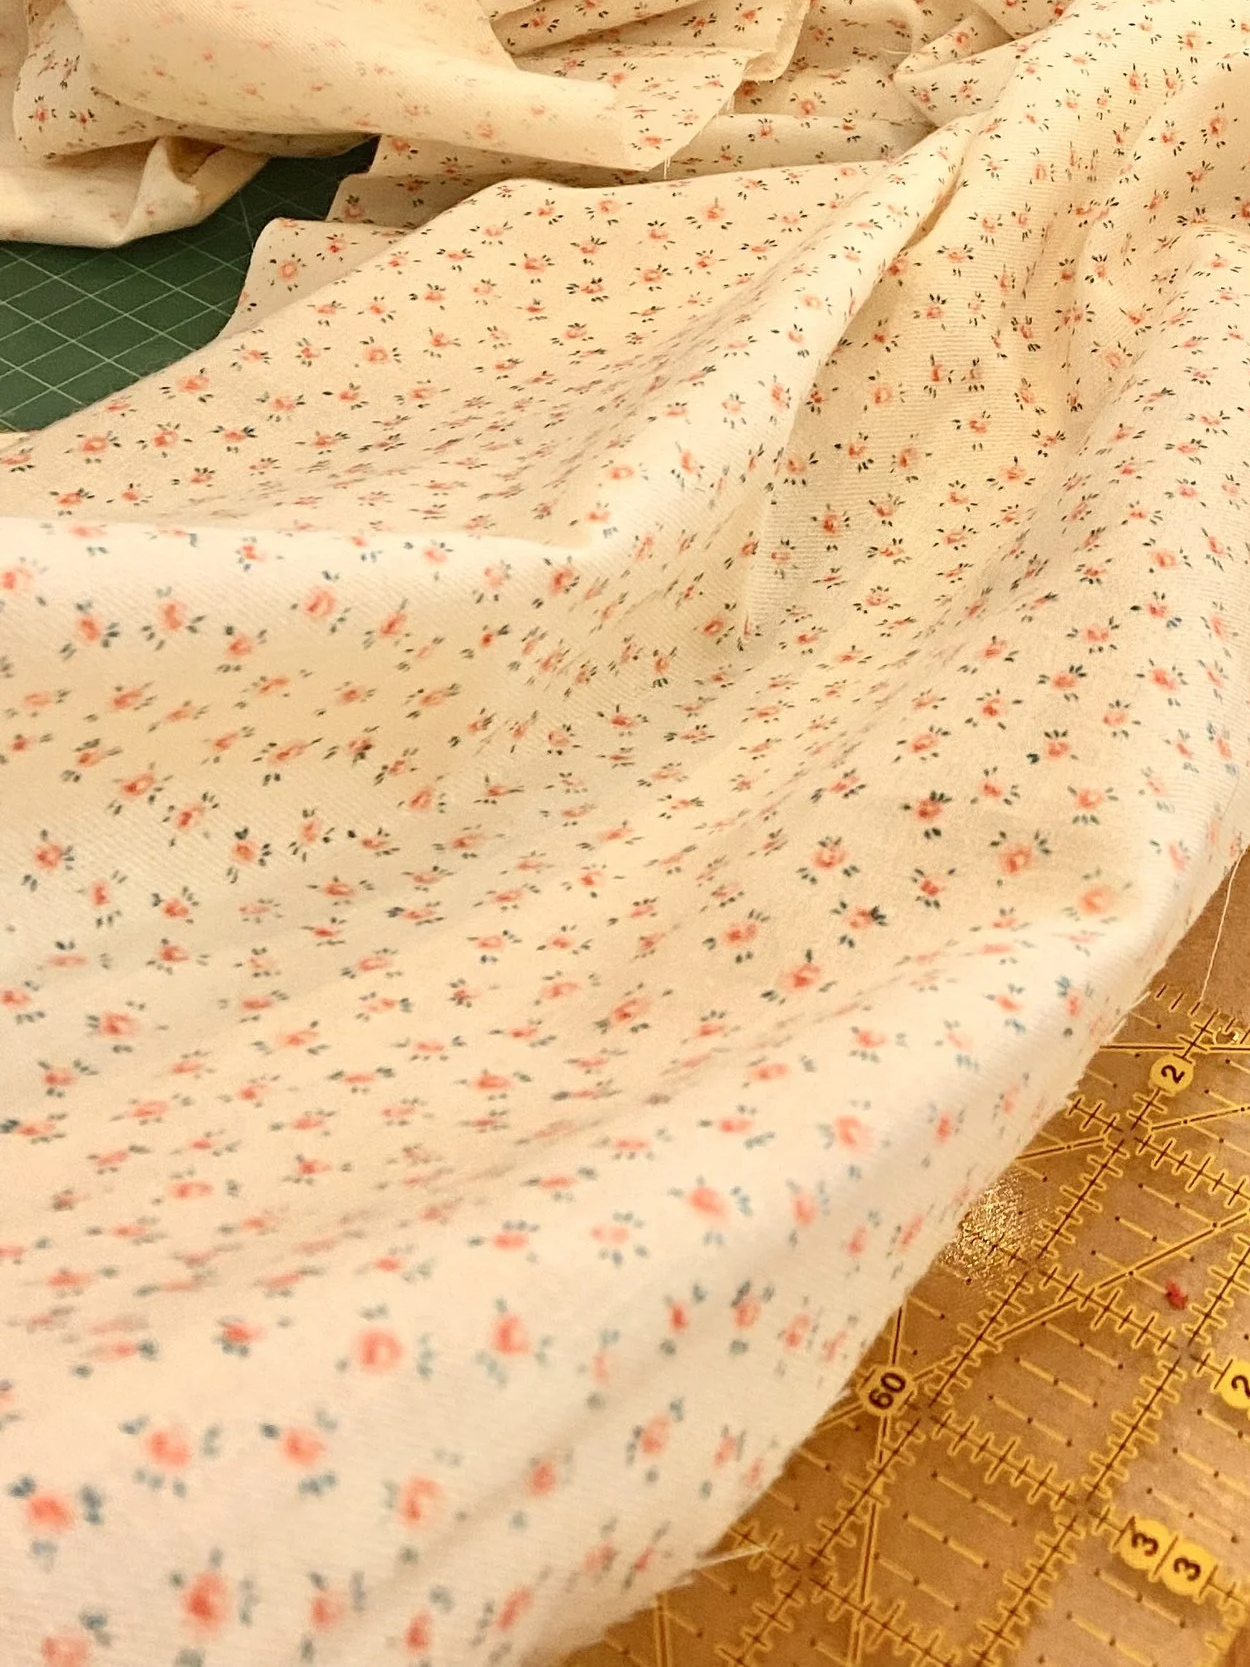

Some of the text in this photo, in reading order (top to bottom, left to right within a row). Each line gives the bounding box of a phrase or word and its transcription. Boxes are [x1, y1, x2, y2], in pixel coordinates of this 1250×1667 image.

[1160, 1064, 1185, 1084] 2
[868, 1372, 906, 1410] 60
[1131, 1532, 1159, 1557] 3
[1173, 1557, 1202, 1582] 3
